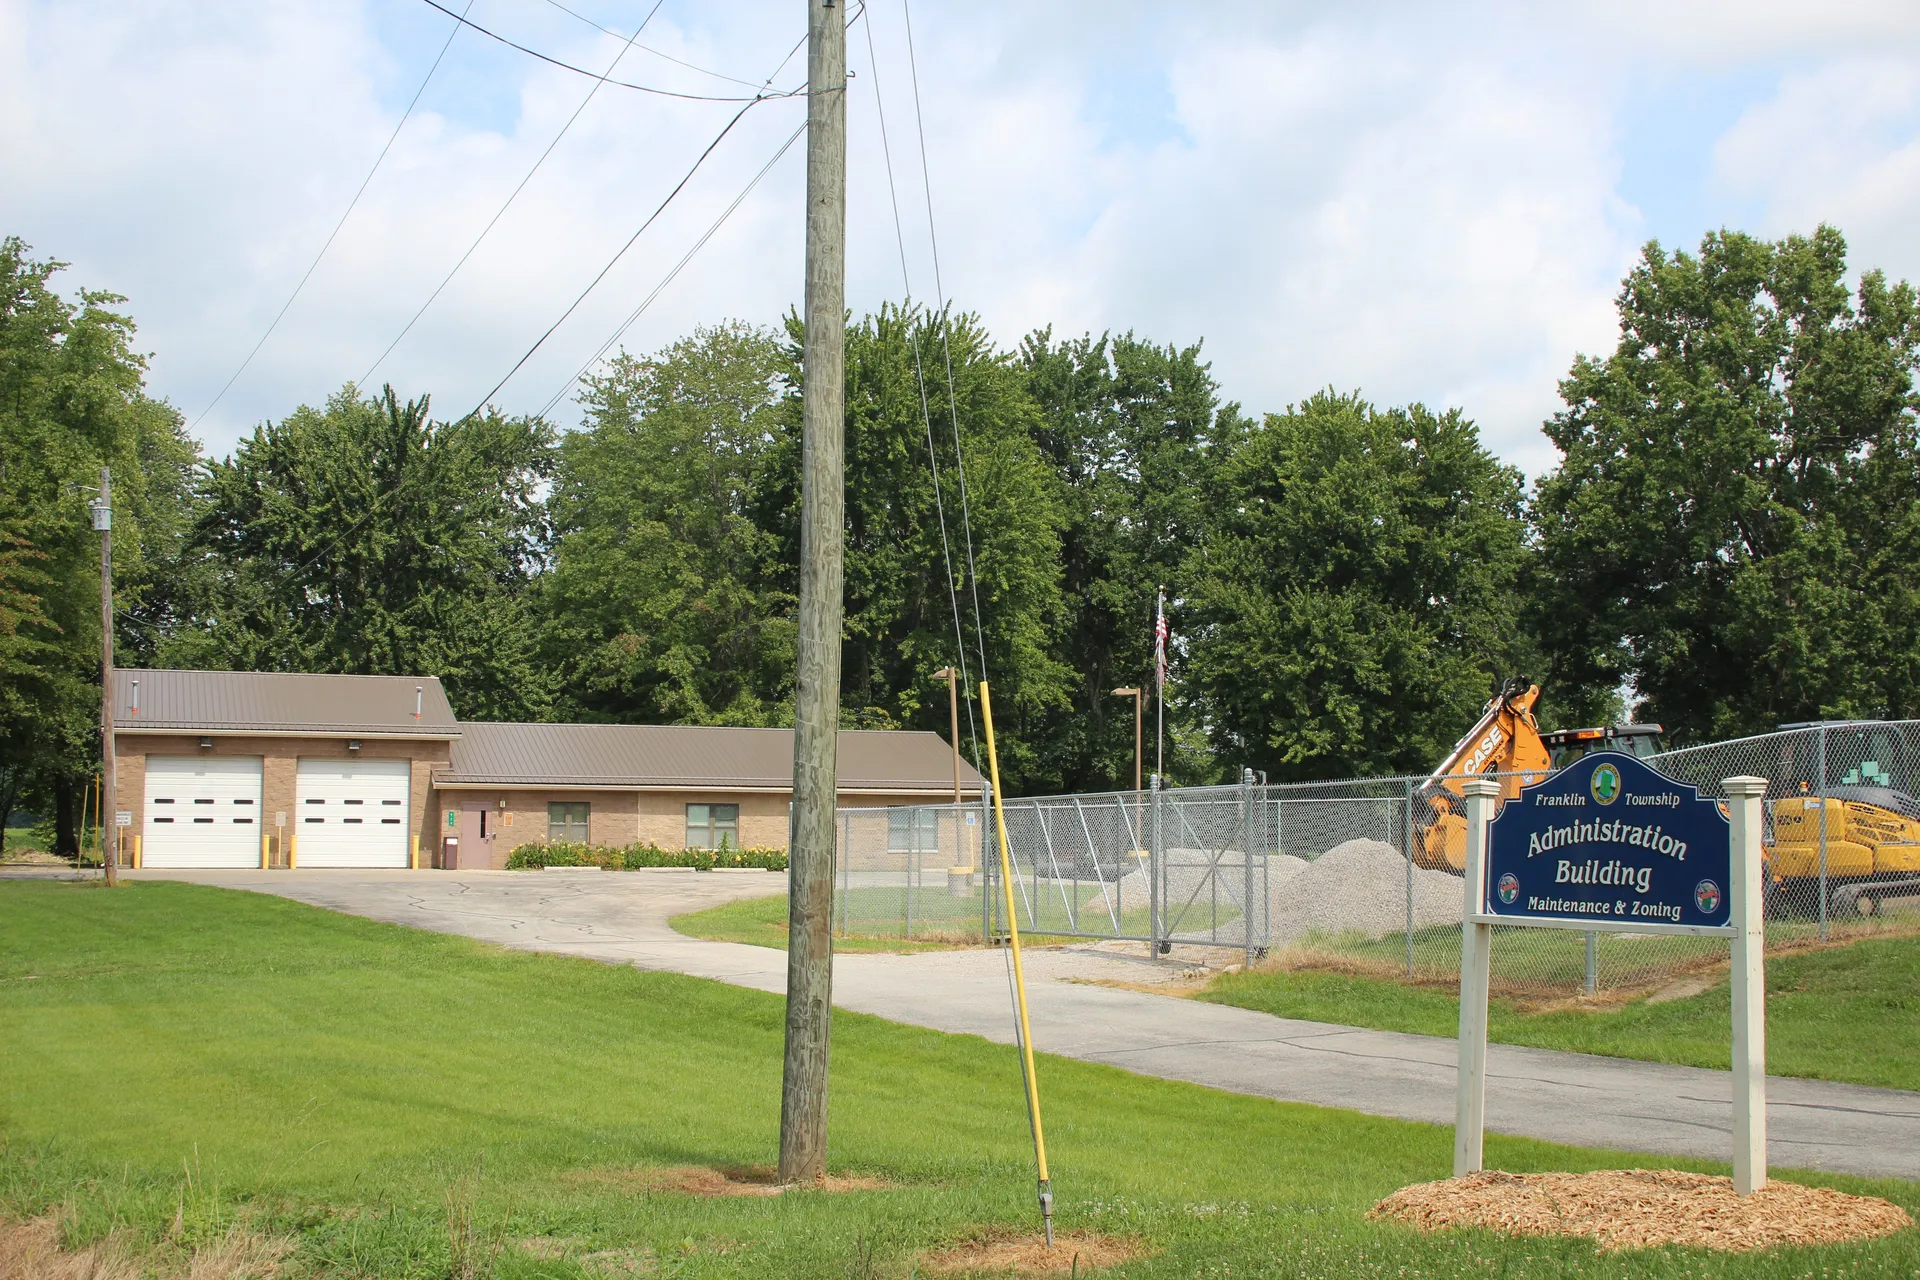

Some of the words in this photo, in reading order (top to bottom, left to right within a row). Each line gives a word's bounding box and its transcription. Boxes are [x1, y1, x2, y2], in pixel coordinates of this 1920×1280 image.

[1463, 725, 1503, 776] CASE
[1535, 794, 1586, 807] Franklin
[1625, 793, 1680, 808] Township
[1527, 817, 1687, 861] Administration
[1555, 860, 1652, 893] Building
[1528, 896, 1610, 914] Maintenance
[1614, 900, 1625, 915] &
[1631, 901, 1682, 921] Zoning
